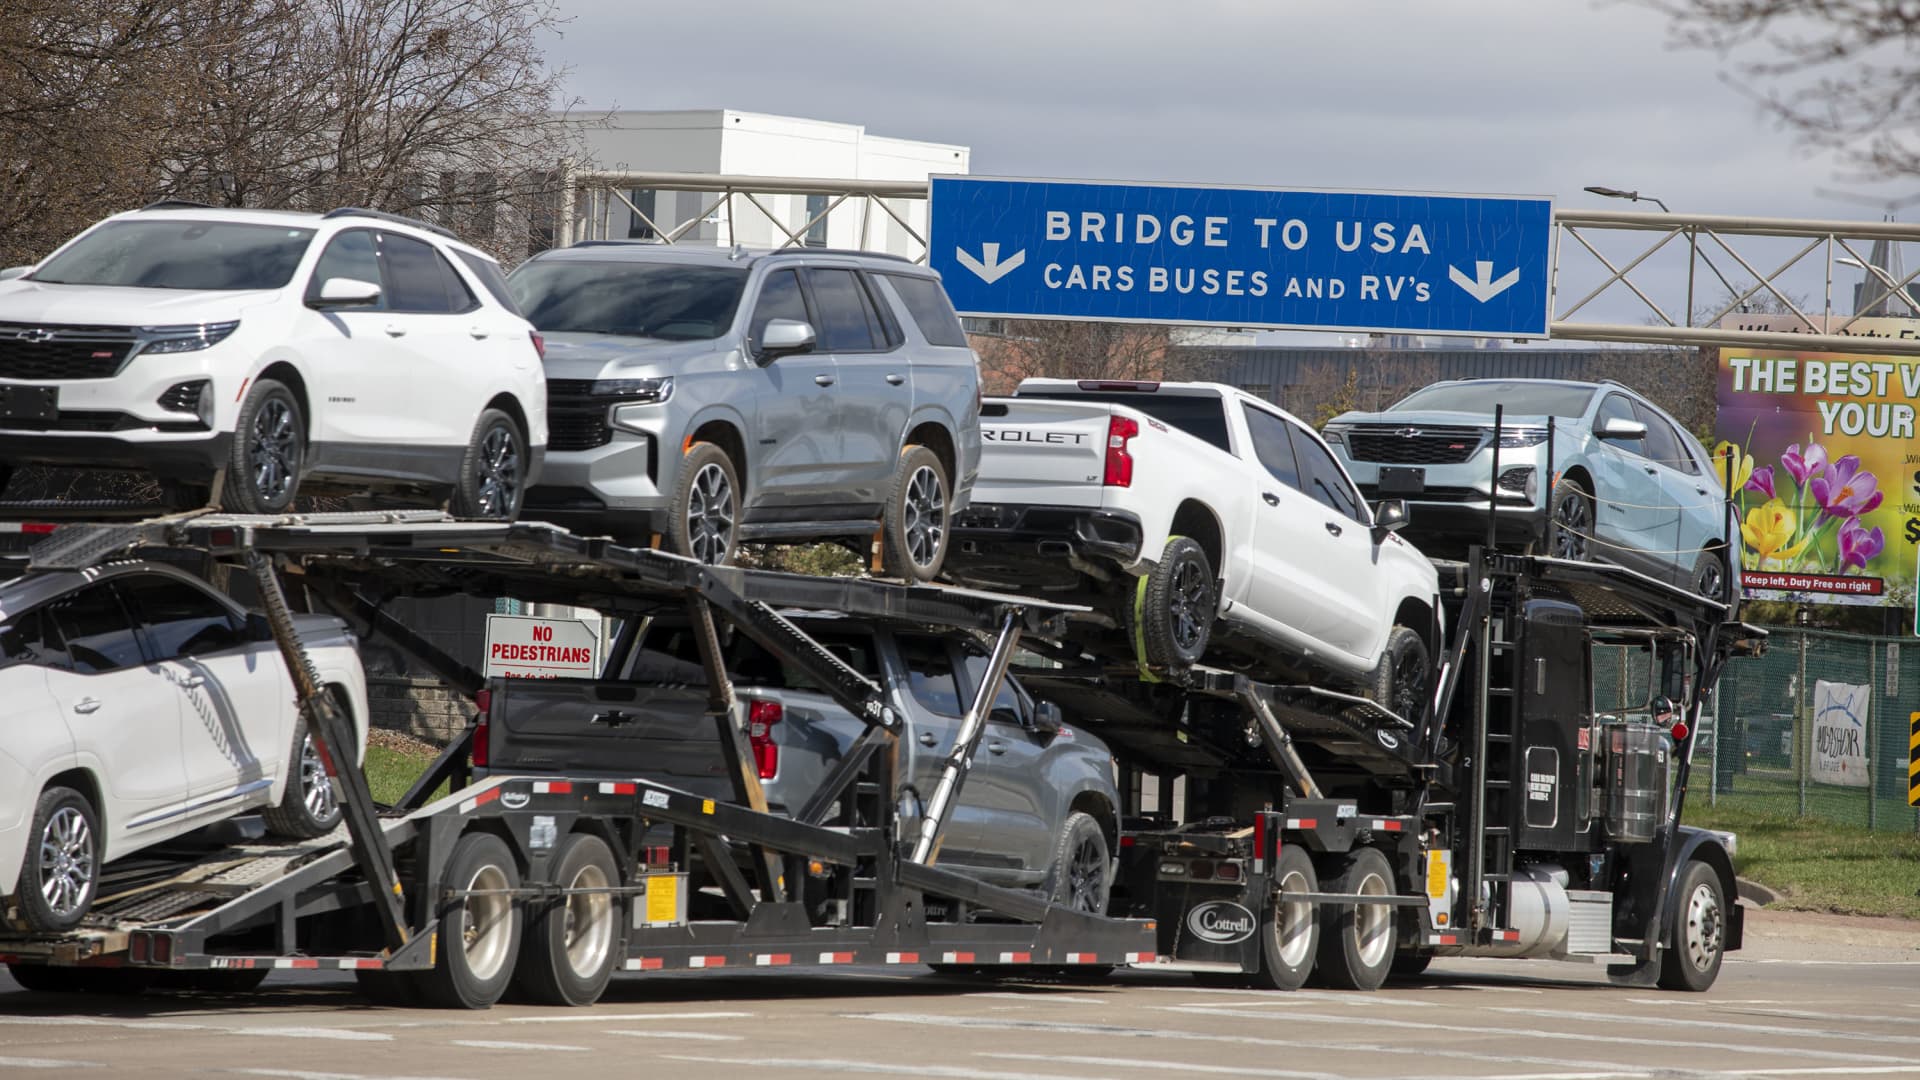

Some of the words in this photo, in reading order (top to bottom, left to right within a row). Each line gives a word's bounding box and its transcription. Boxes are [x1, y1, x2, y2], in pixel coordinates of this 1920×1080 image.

[1045, 210, 1229, 248] BRIDGE
[1254, 217, 1309, 251] TO
[1335, 221, 1432, 256] USA
[1043, 263, 1135, 292] CARS
[1149, 267, 1269, 298] BUSES
[1283, 277, 1346, 301] AND
[1360, 276, 1432, 304] RV's
[1729, 357, 1797, 394] THE
[1804, 361, 1893, 397] BEST
[1818, 401, 1916, 438] YOUR
[1744, 574, 1768, 585] Keep
[1769, 577, 1788, 587] left,
[1789, 577, 1812, 589] Duty
[1813, 579, 1834, 589] Free
[1848, 581, 1872, 592] right
[532, 625, 553, 642] NO
[491, 643, 591, 663] PEDESTRIANS
[1203, 910, 1249, 932] Cottrell
